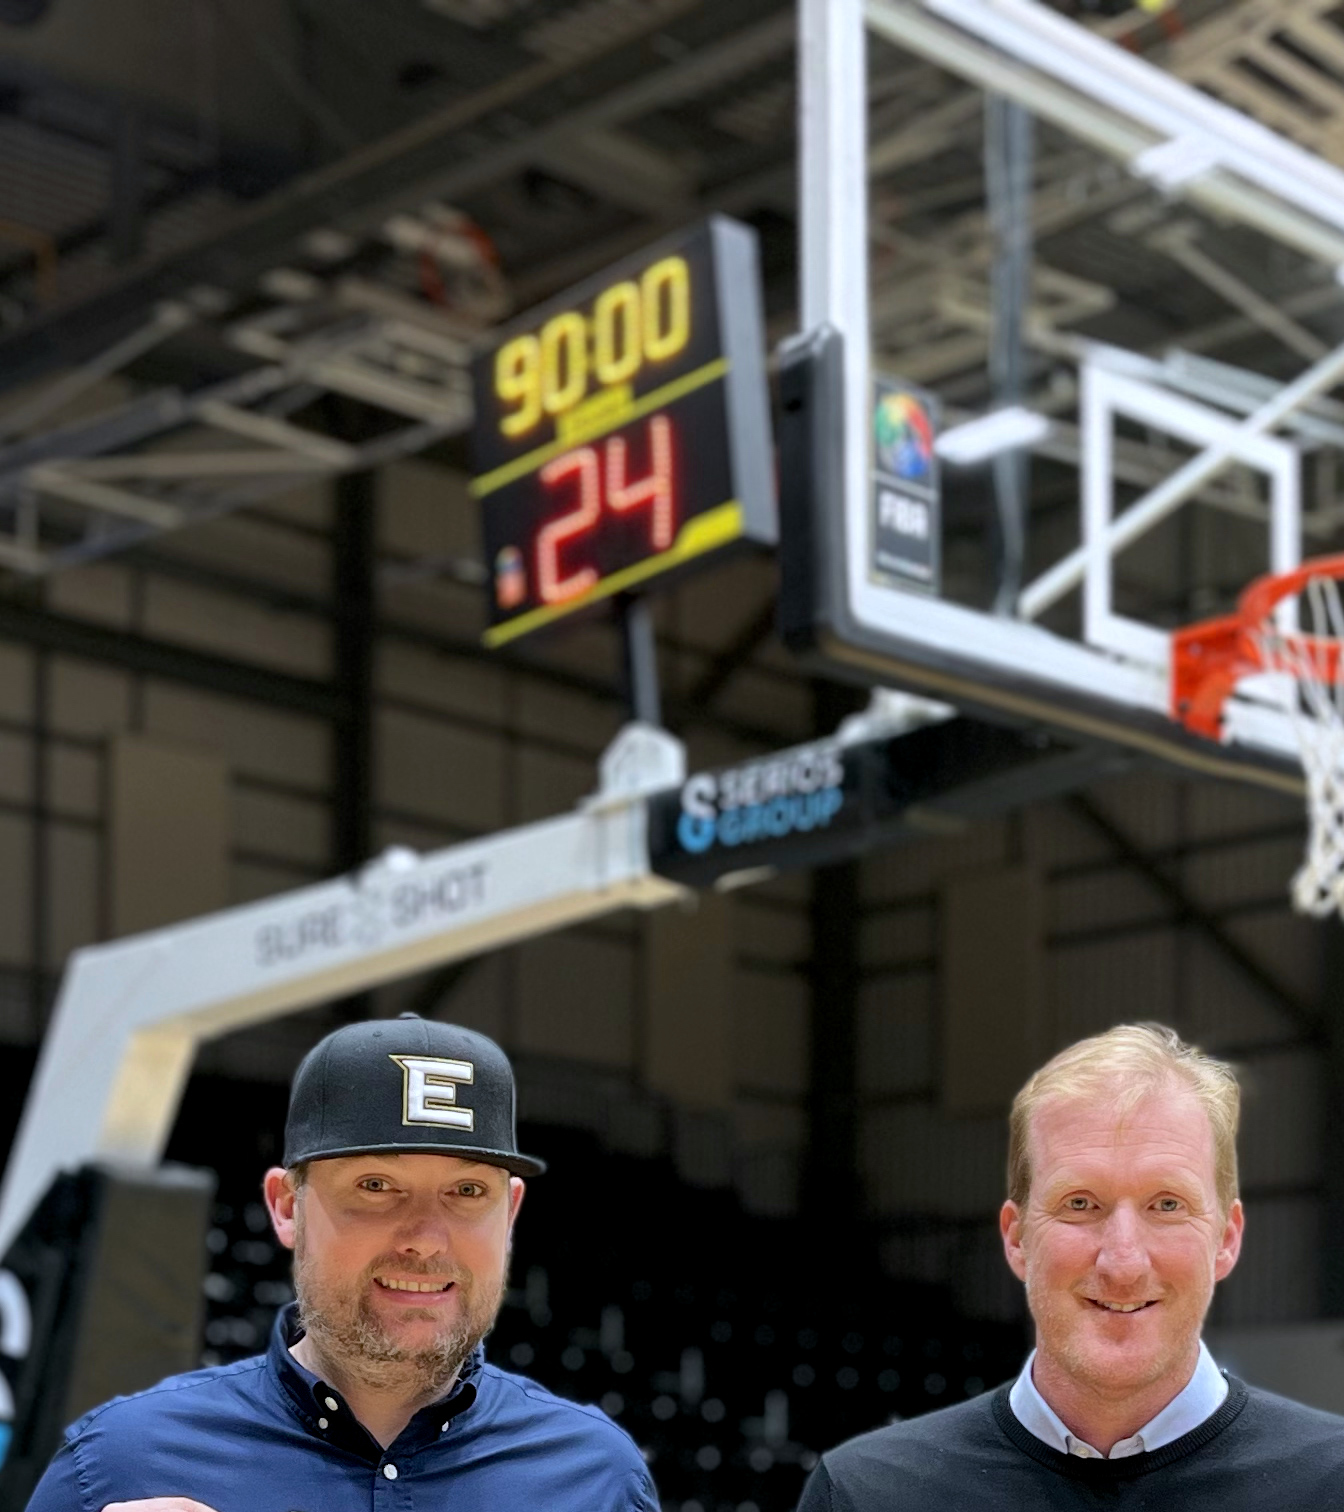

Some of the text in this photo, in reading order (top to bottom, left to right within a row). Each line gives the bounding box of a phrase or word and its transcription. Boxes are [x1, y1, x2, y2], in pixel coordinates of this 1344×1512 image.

[536, 413, 673, 605] 24
[716, 786, 844, 847] GROUP
[389, 861, 489, 928] SHOT
[389, 1054, 474, 1132] E
